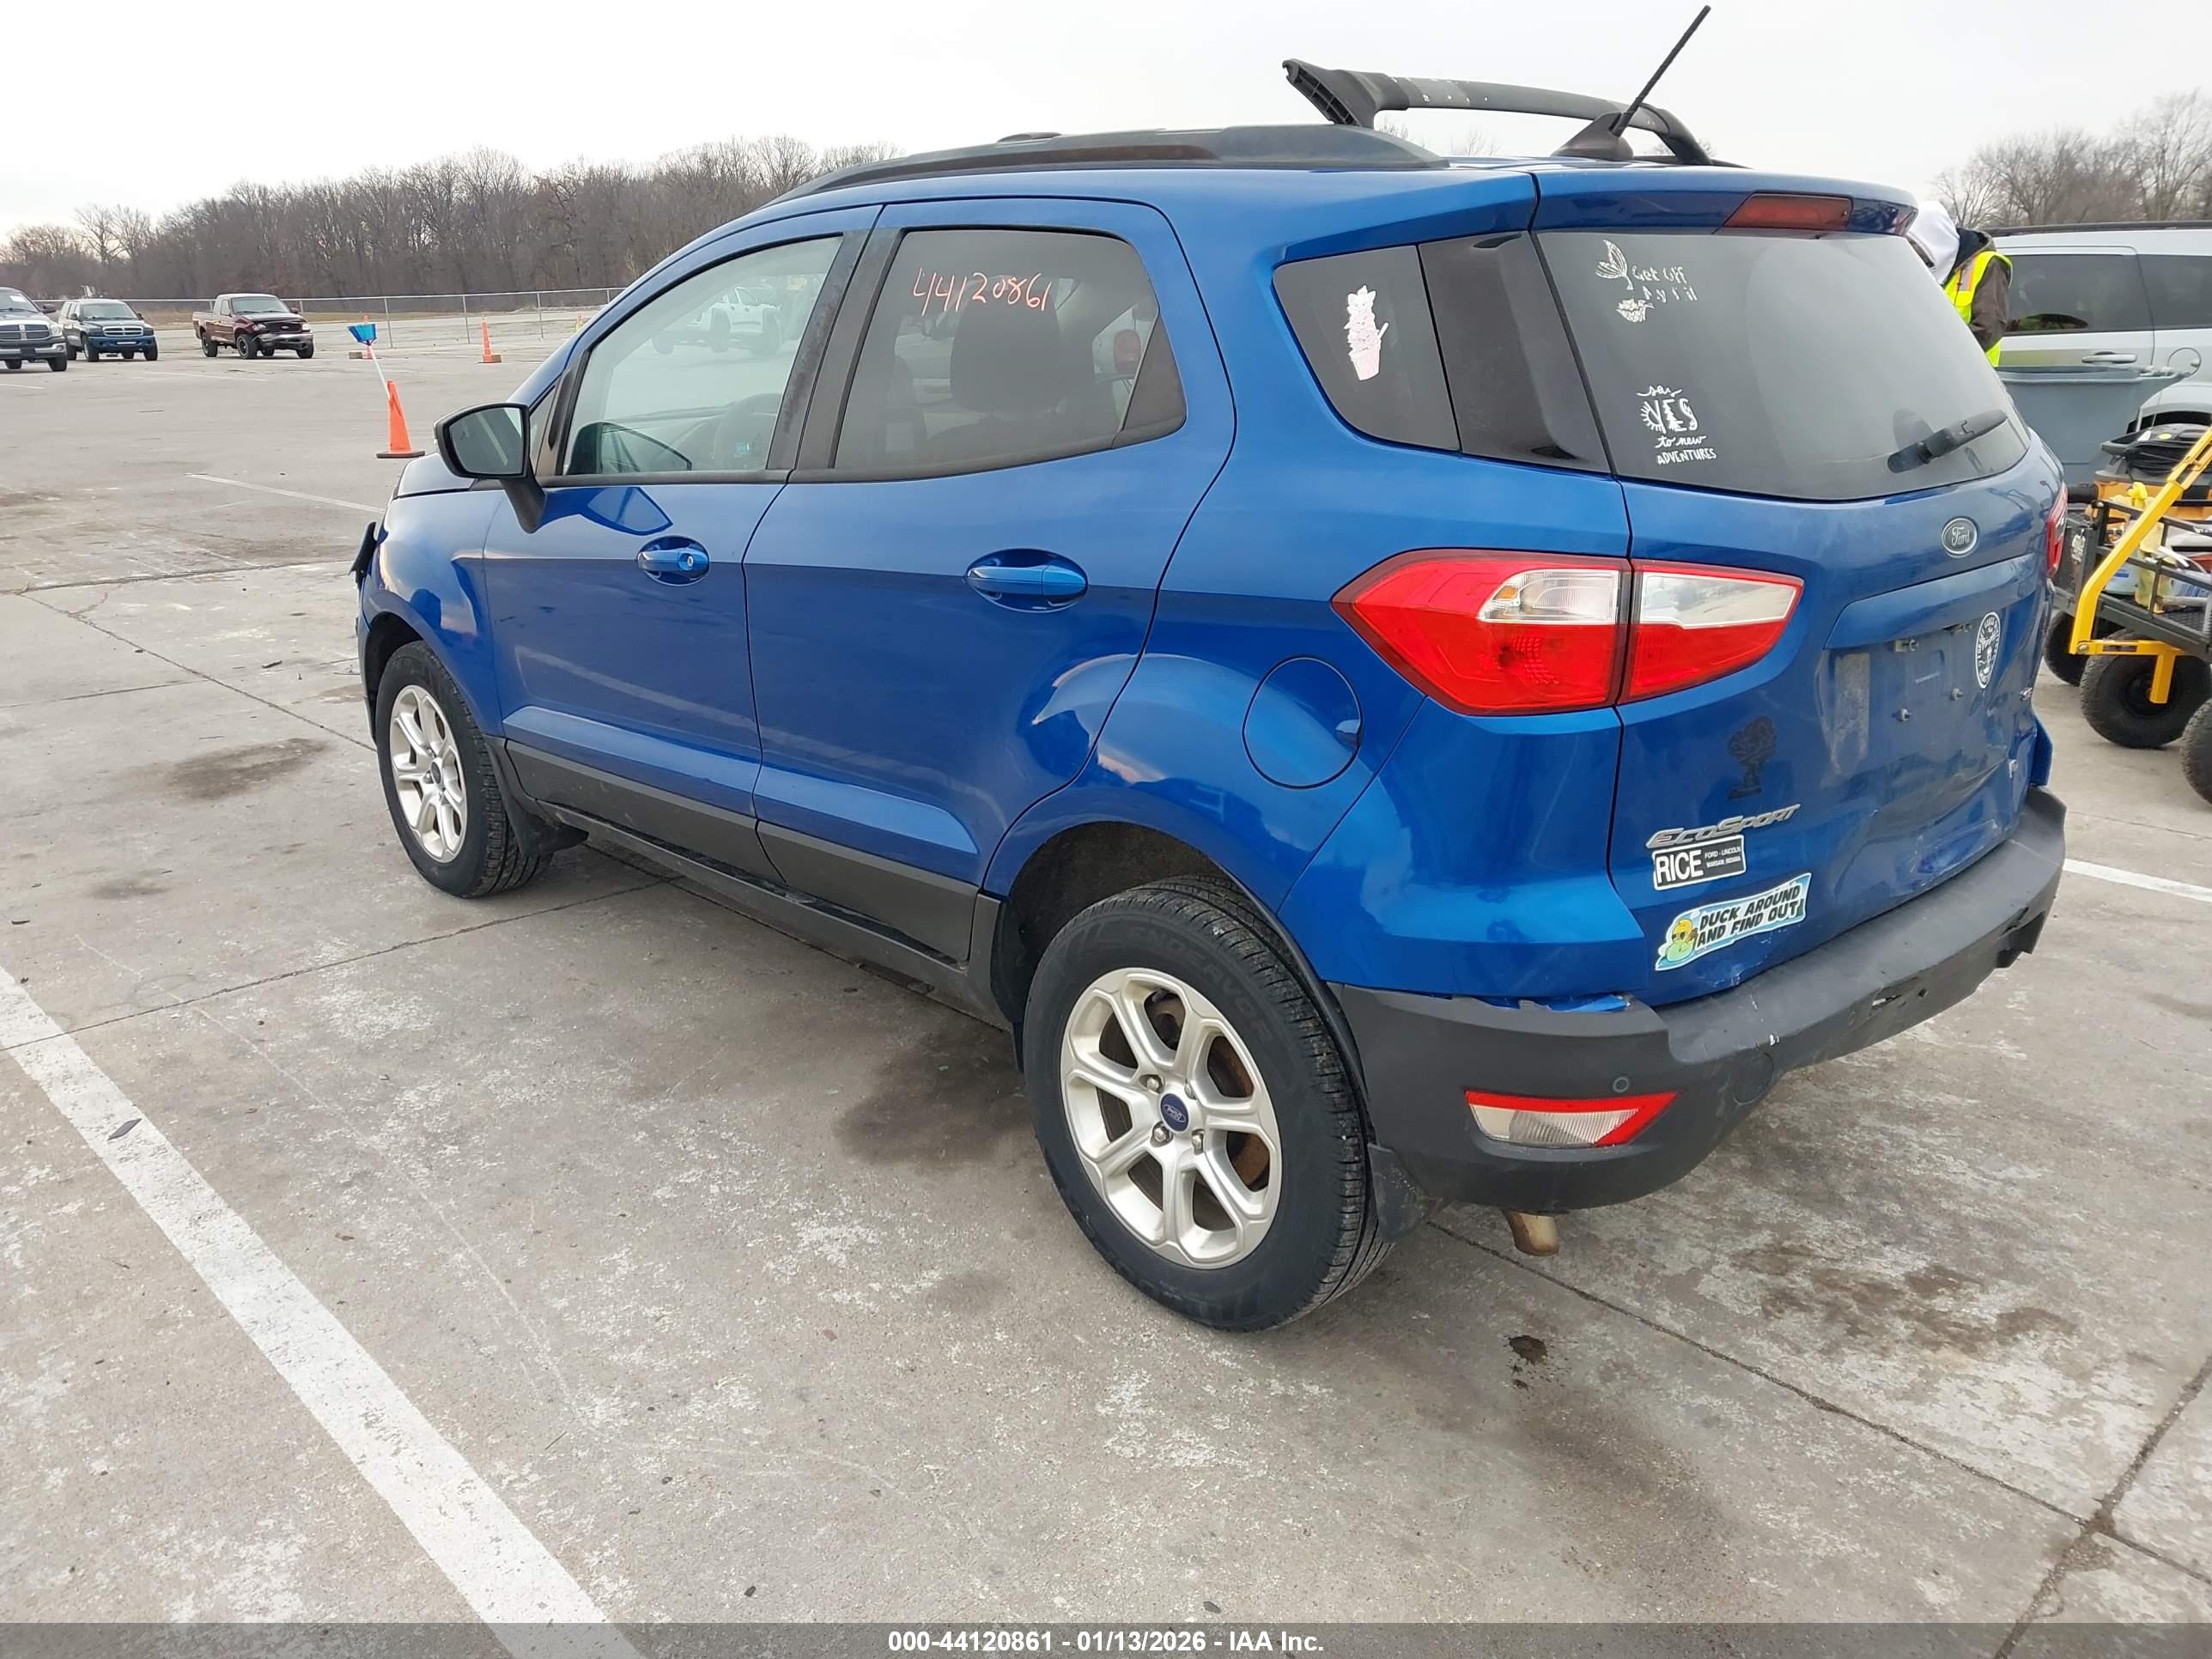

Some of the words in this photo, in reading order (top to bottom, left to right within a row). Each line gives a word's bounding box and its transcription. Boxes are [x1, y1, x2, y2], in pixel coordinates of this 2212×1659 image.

[912, 267, 1053, 317] 44120861
[1640, 398, 1698, 434] YES
[1654, 435, 1676, 448] to
[1675, 435, 1707, 447] new
[1656, 447, 1718, 465] ADVENTURES
[1951, 526, 1970, 547] Ford
[1656, 849, 1705, 884] RICE
[1705, 851, 1718, 860] FORD
[1721, 846, 1741, 856] LINCOLN
[1700, 906, 1740, 930] DUCK
[1744, 884, 1802, 916] AROUND
[1697, 925, 1726, 948] AND
[1730, 912, 1763, 935] FIND
